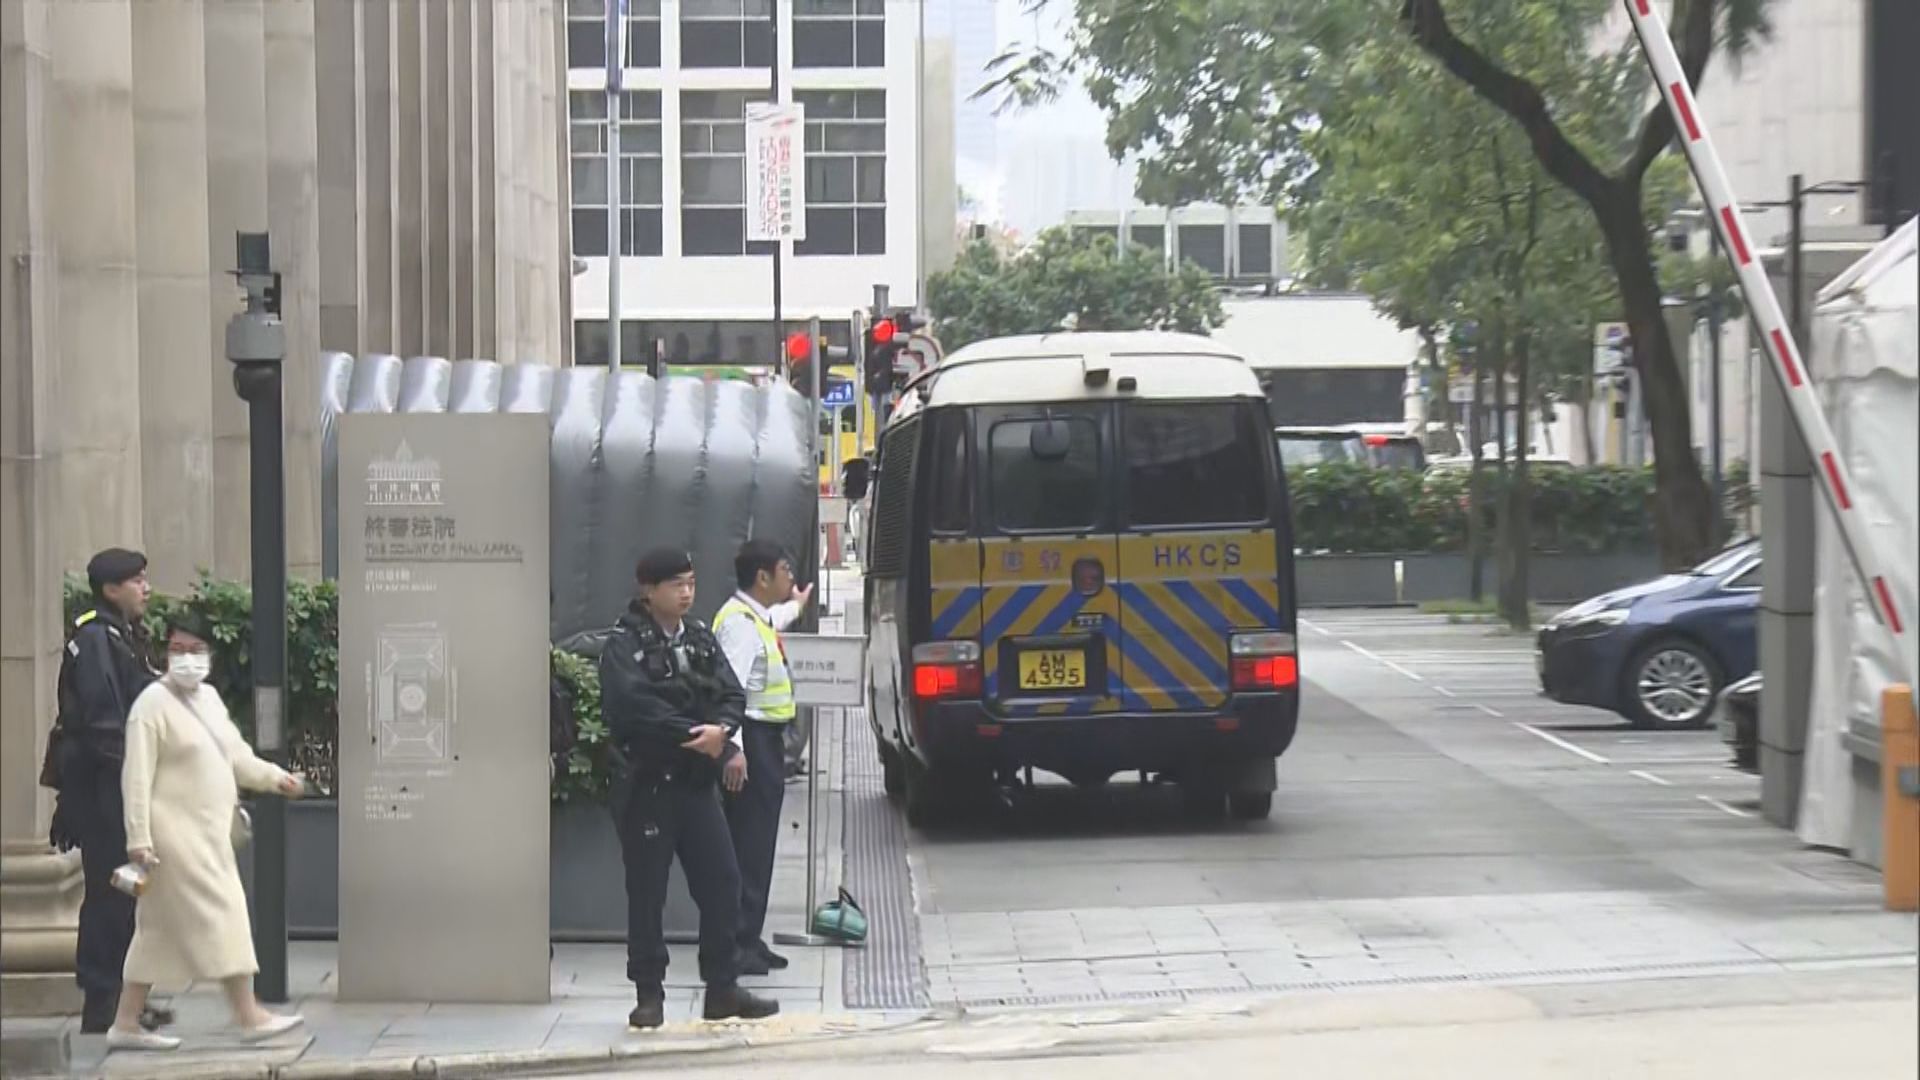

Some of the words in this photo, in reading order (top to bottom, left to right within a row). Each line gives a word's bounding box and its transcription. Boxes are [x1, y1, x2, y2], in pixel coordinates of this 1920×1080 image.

[364, 516, 456, 540] 終審法院
[1155, 543, 1241, 566] HKCS
[1040, 653, 1065, 670] AM
[1025, 668, 1081, 685] 4395
